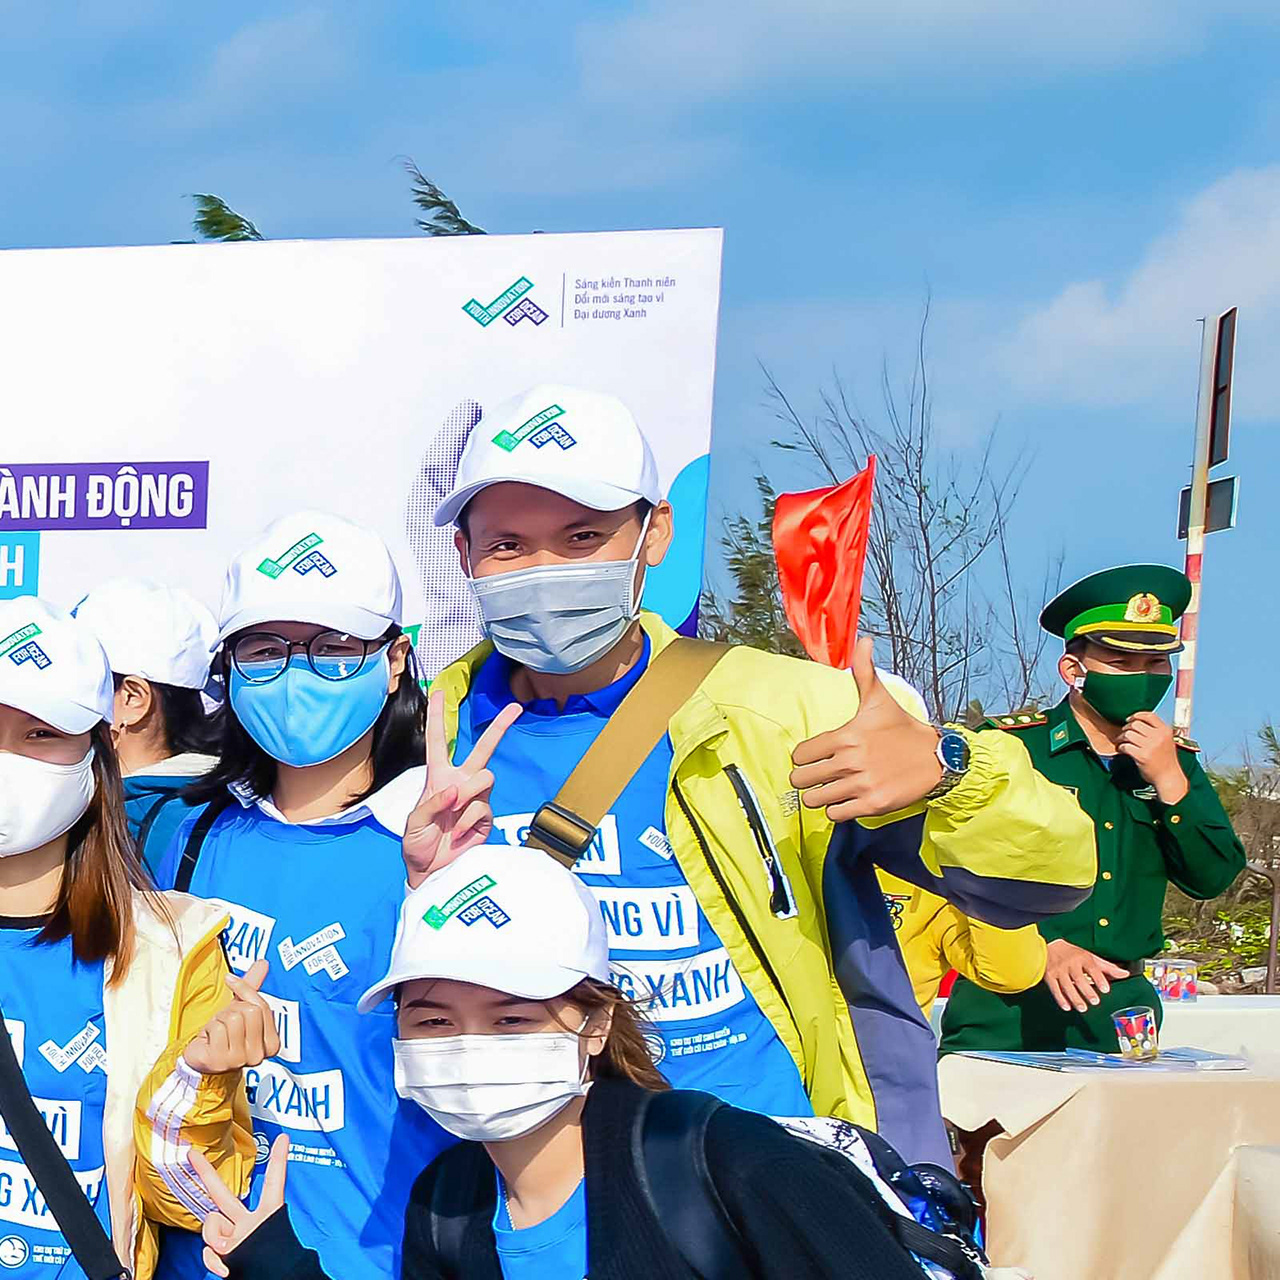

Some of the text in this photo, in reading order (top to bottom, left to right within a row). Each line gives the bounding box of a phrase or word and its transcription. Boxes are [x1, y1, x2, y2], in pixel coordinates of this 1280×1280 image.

[575, 278, 598, 291] Sáng
[624, 276, 653, 288] Thanh
[613, 292, 635, 306] sáng
[624, 307, 647, 319] Xanh
[86, 465, 194, 526] ĐỘNG
[652, 893, 685, 937] VÌ
